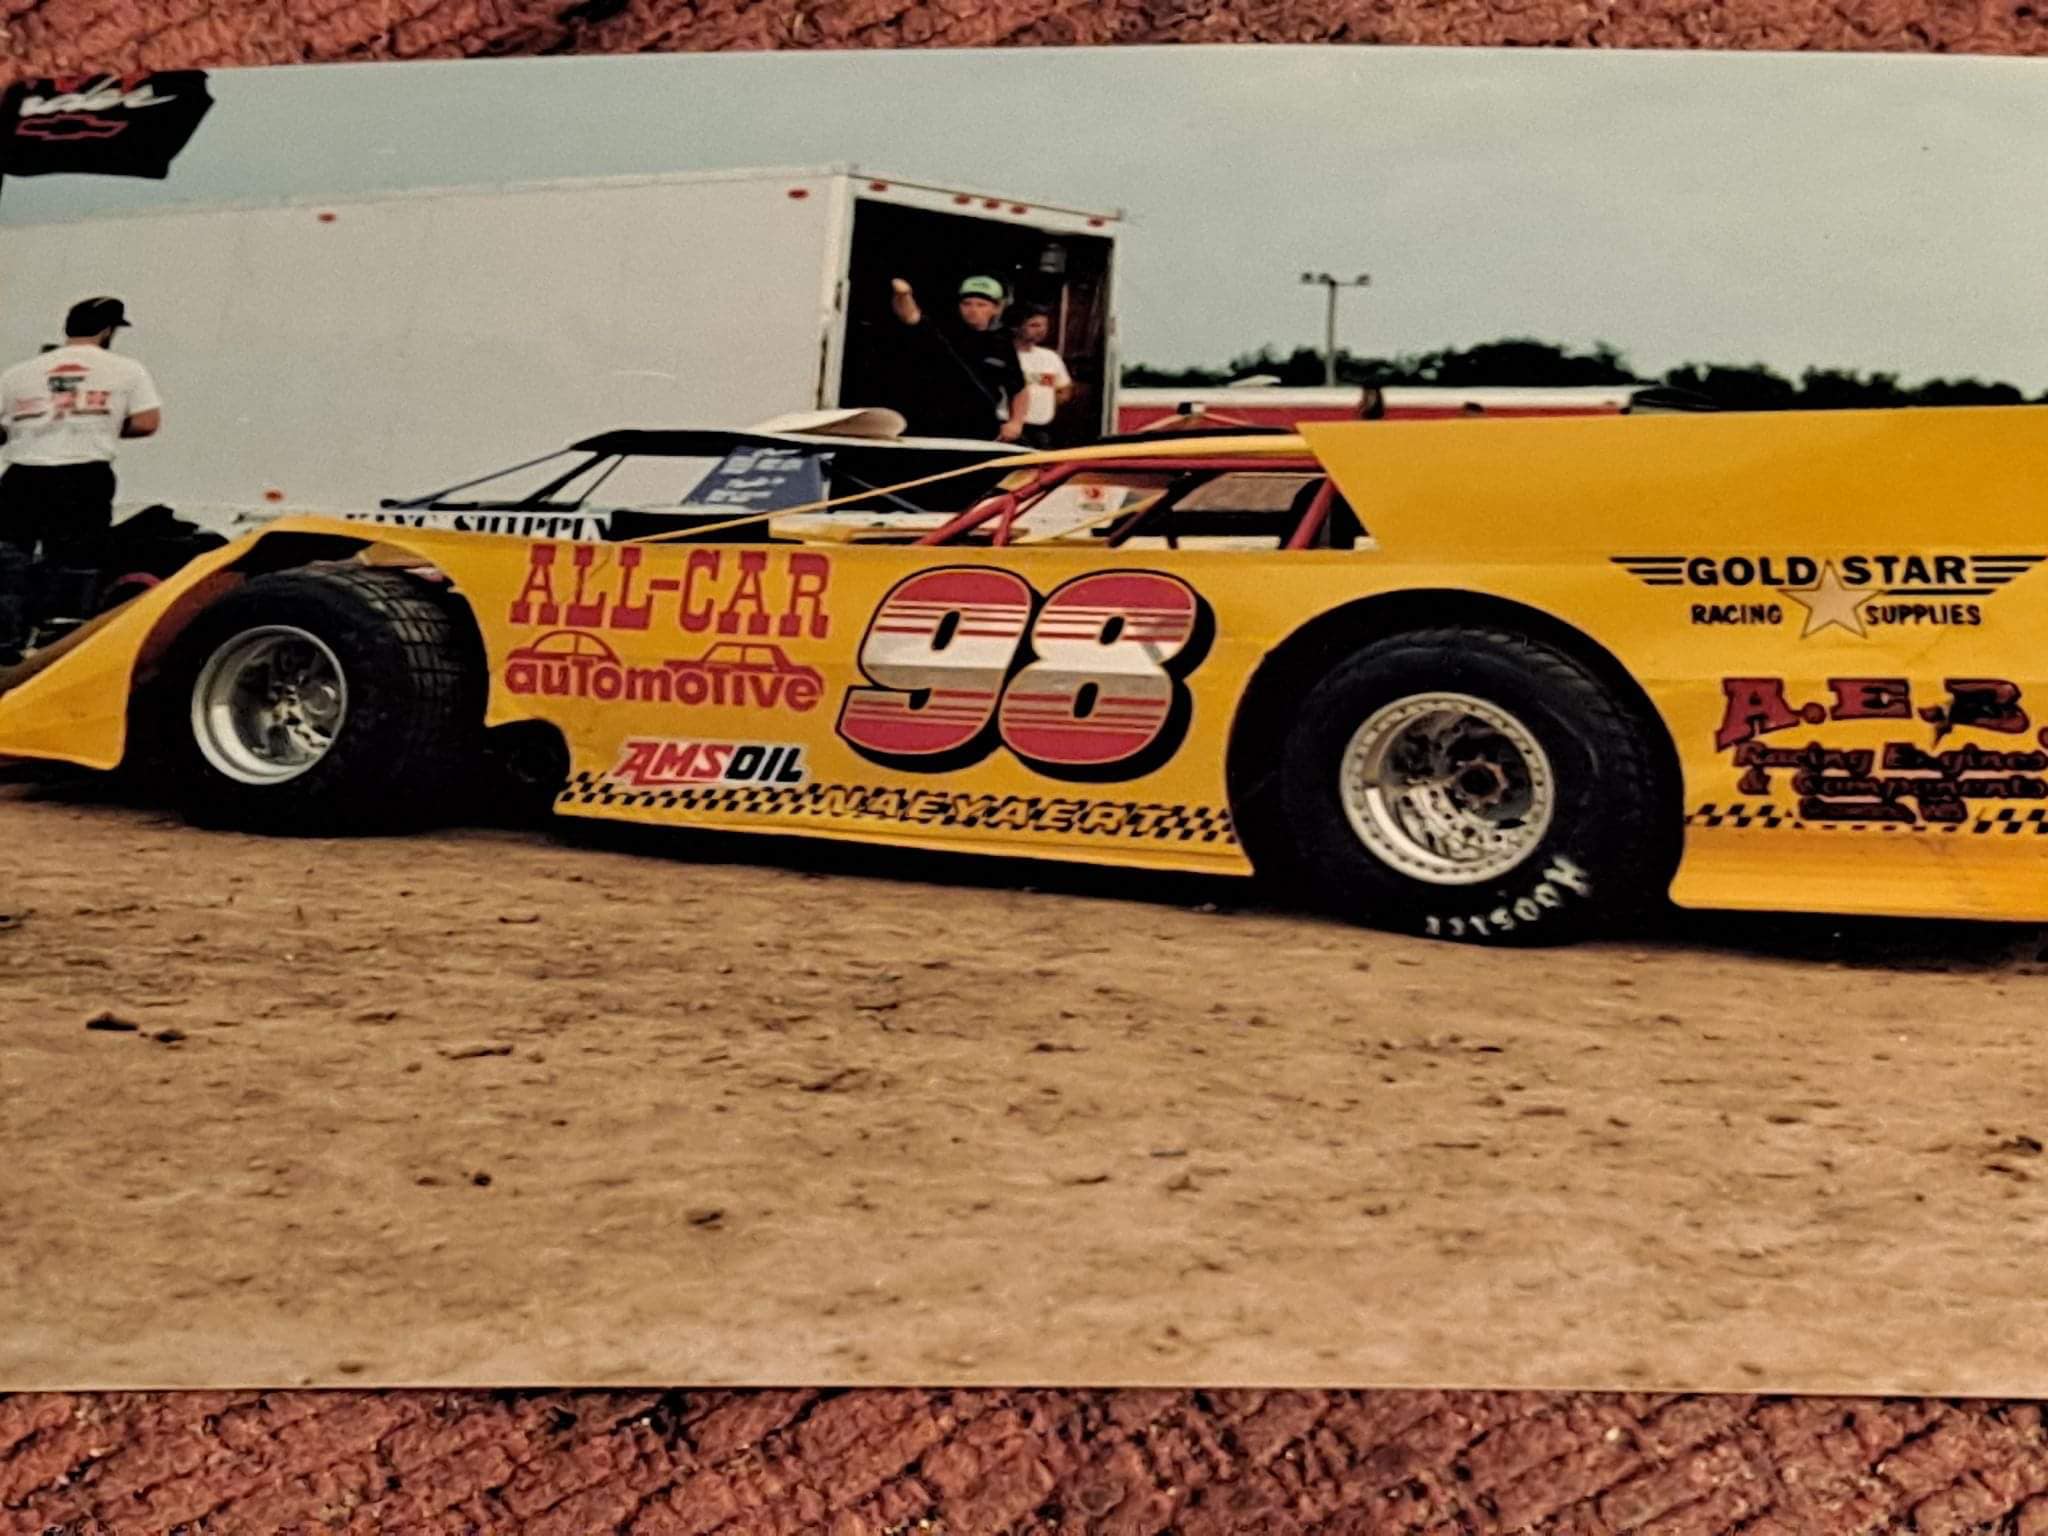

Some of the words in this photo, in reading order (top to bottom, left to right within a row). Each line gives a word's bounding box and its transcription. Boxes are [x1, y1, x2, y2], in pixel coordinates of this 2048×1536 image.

[509, 544, 832, 638] ALL-CAR
[1687, 556, 1816, 586] GOLD
[1842, 555, 1967, 585] STAR
[1691, 605, 1783, 625] RACING
[1866, 604, 1982, 626] SUPPLIES
[835, 564, 1216, 783] 98
[616, 741, 807, 785] AMSOIL
